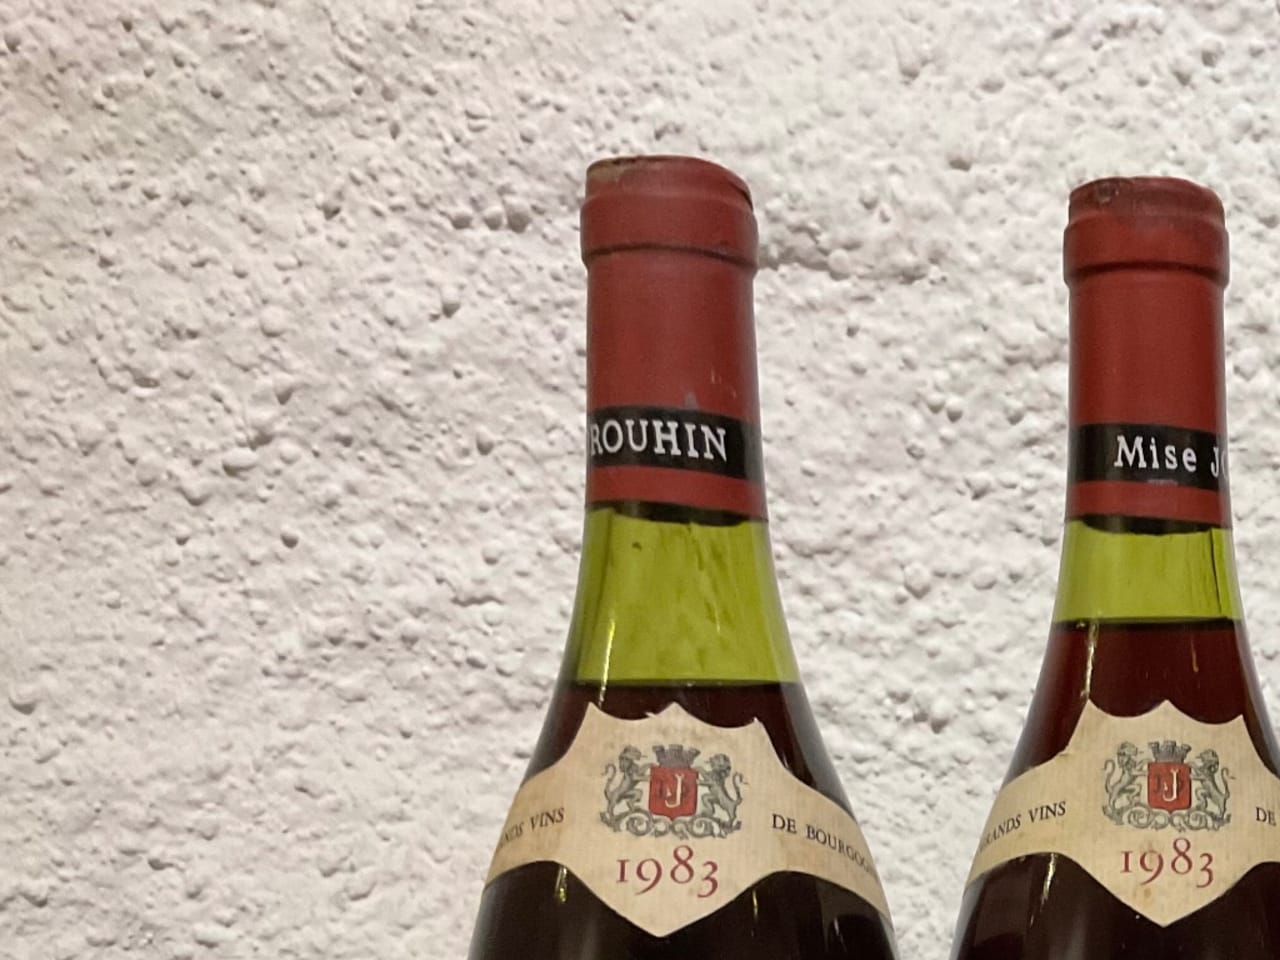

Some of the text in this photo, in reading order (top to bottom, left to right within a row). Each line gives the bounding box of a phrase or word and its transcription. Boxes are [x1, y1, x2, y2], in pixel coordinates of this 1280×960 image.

[1113, 434, 1198, 473] Mise
[530, 806, 565, 832] VINS
[771, 813, 797, 834] DE
[1028, 800, 1066, 823] VINS
[1255, 806, 1277, 827] DE
[616, 844, 719, 899] 1983
[1120, 837, 1215, 890] 1983
